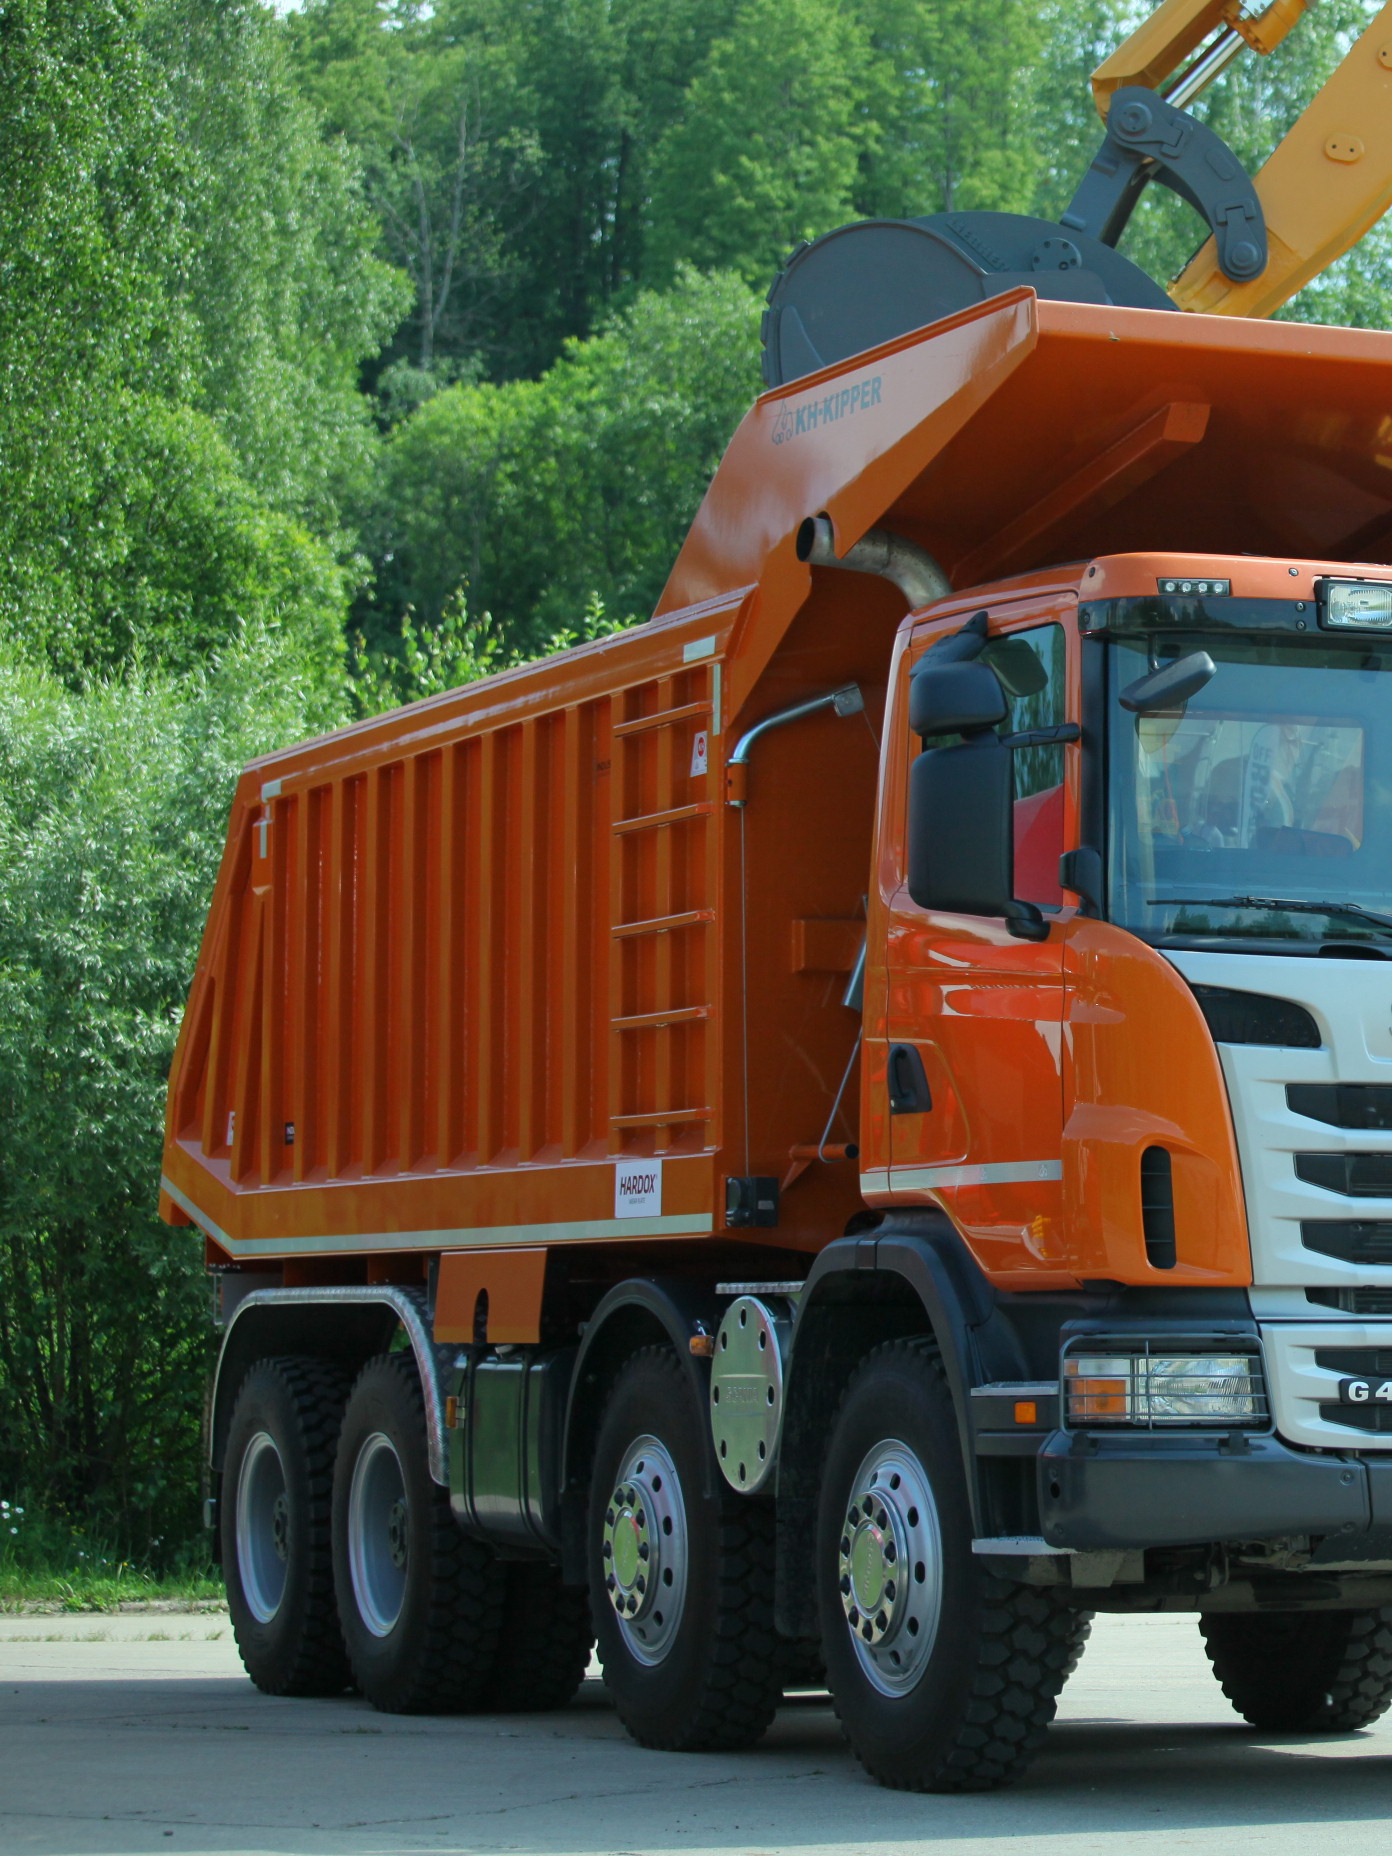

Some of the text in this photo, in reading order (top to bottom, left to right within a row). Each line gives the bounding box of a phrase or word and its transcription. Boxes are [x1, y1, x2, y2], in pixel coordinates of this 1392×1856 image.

[795, 376, 882, 435] KH-KIPPER
[620, 1174, 656, 1195] HARDOX
[1348, 1381, 1369, 1401] G
